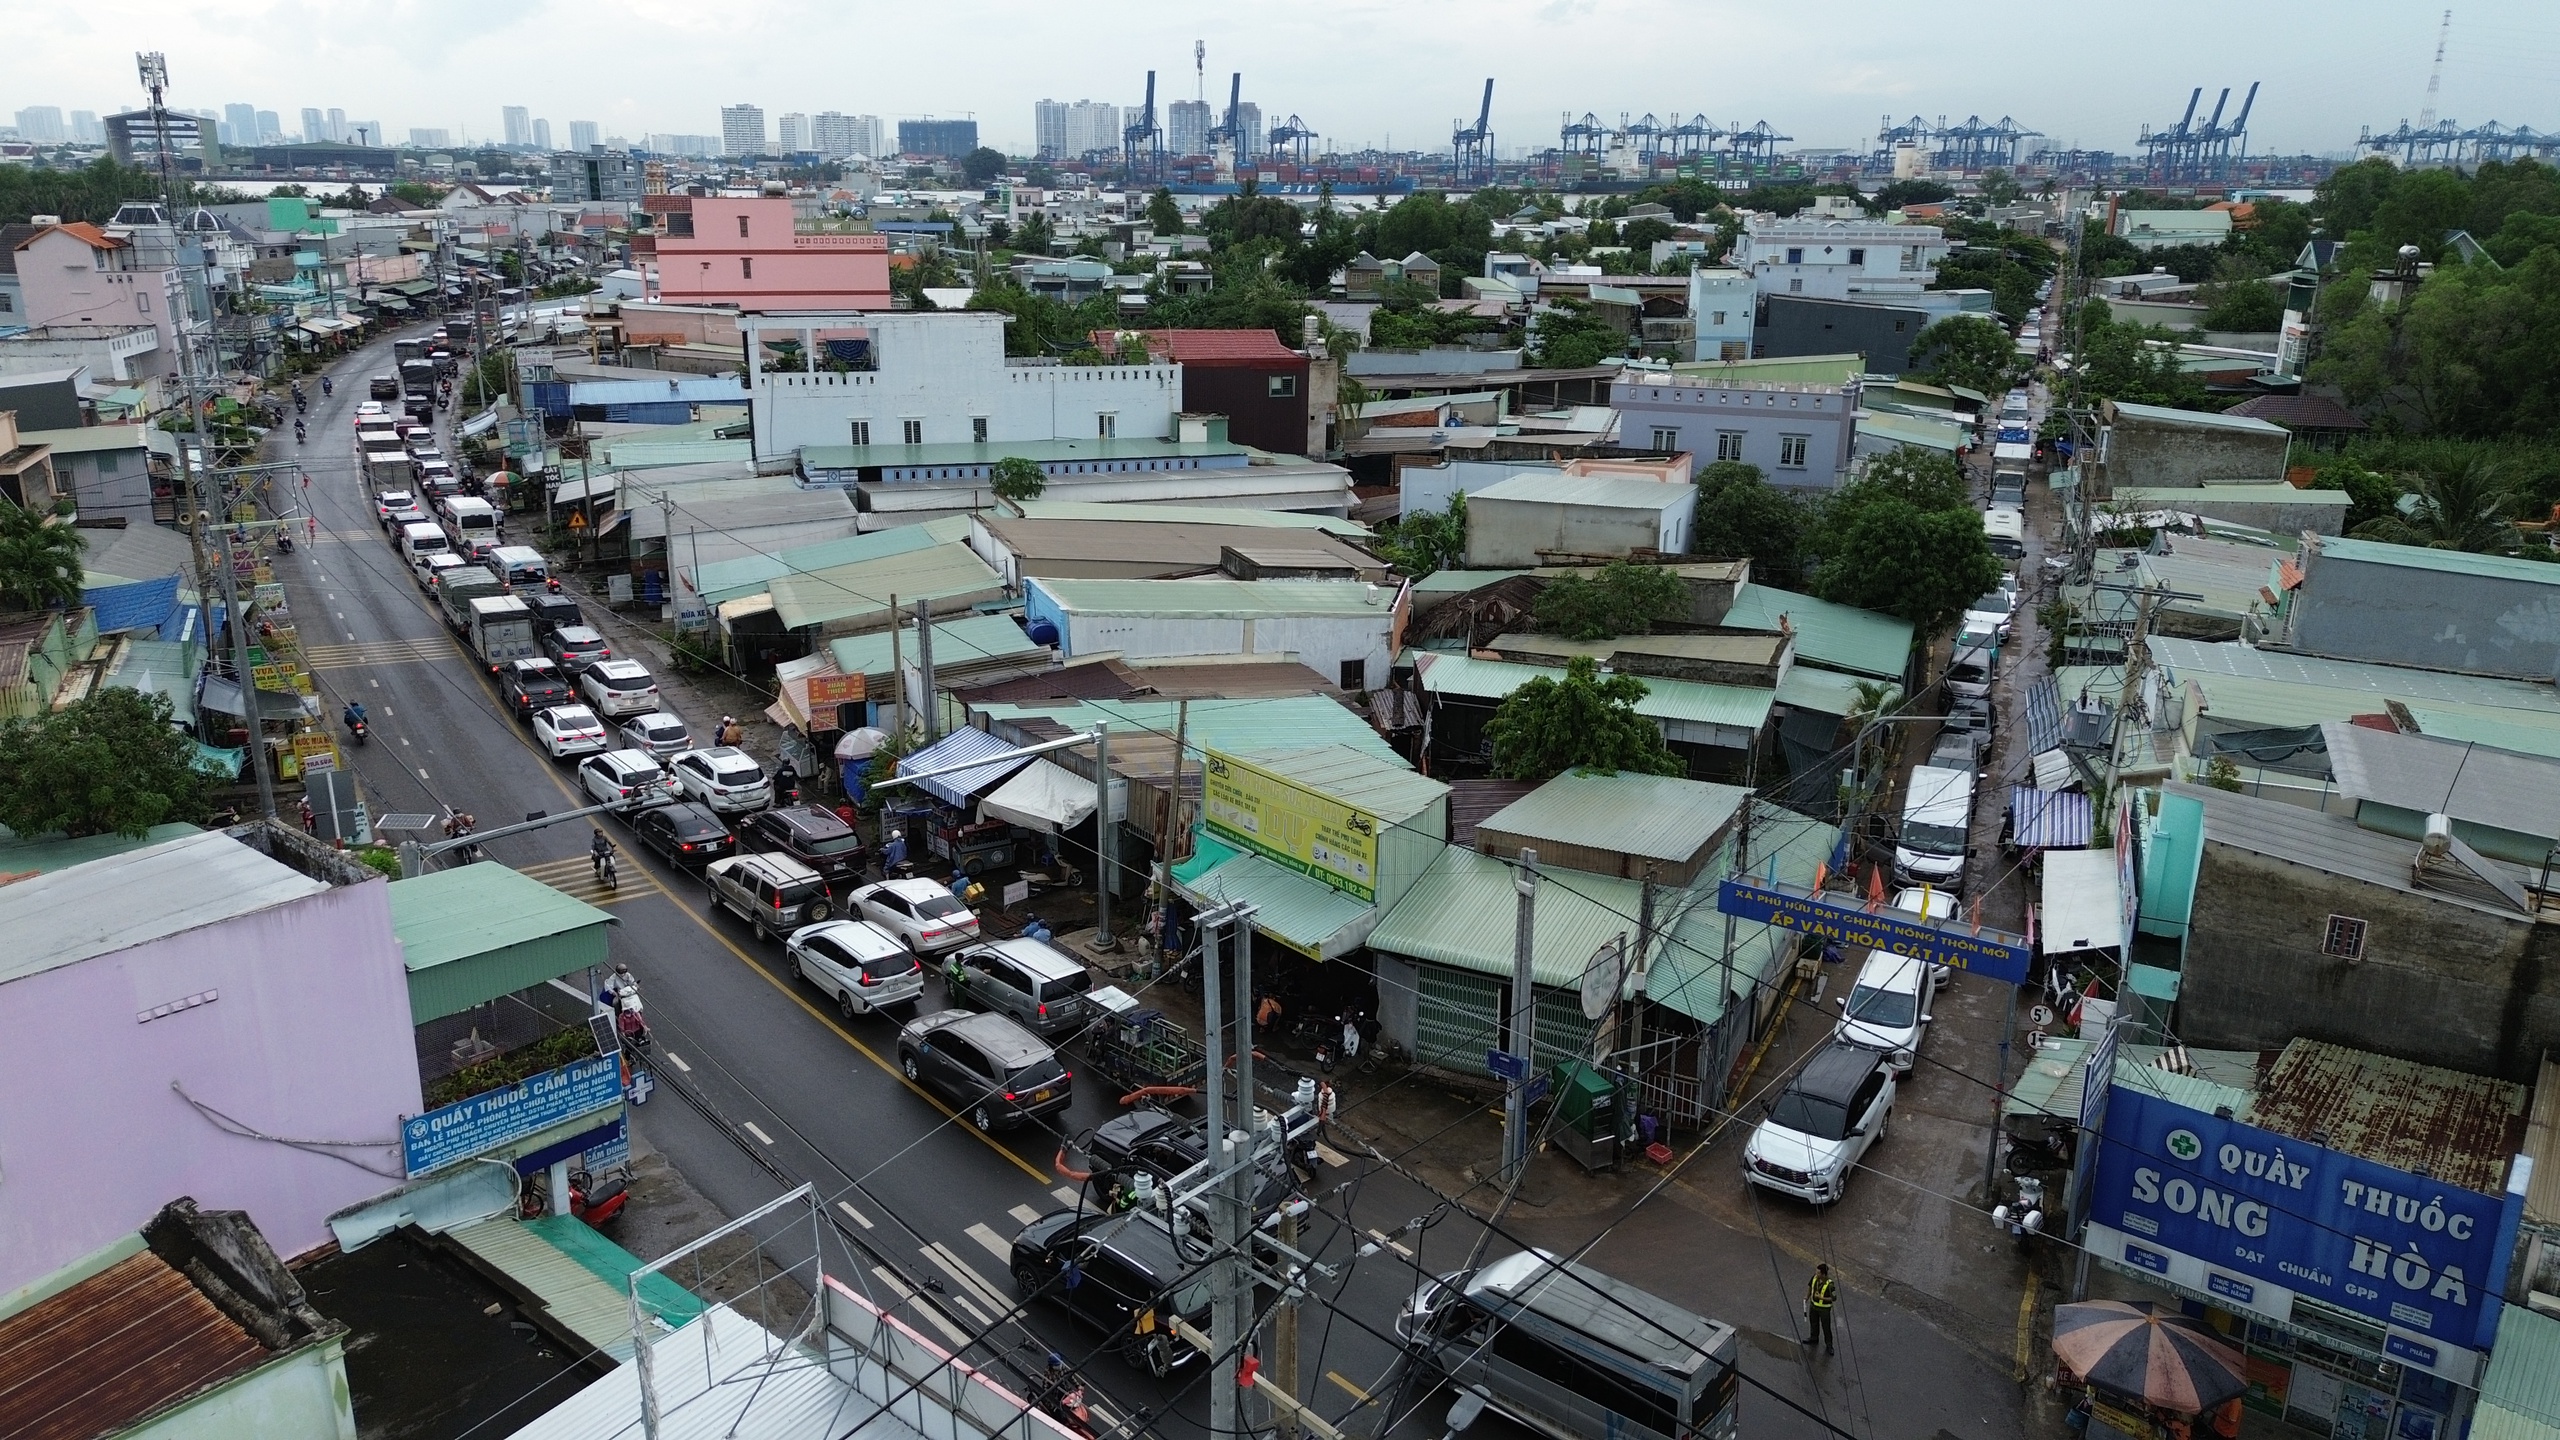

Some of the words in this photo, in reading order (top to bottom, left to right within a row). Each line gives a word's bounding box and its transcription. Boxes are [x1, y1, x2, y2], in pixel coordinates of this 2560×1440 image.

[545, 481, 561, 489] NAM
[681, 609, 696, 619] RỬA
[697, 609, 706, 618] XE
[1320, 822, 1332, 835] THAY
[1331, 826, 1340, 839] THẾ
[1340, 830, 1349, 844] PHỤ
[1340, 841, 1351, 853] CÁC
[1361, 850, 1367, 860] XE
[1314, 867, 1325, 881] ĐT:
[1735, 888, 1753, 900] XÃ
[1757, 894, 1781, 907] PHÚ
[1785, 900, 1811, 914] HỮU
[1814, 907, 1839, 921] ĐẠT
[1843, 914, 1891, 932] CHUẨN
[1895, 926, 1936, 942] NÔNG
[1940, 936, 1979, 952] THÔN
[1982, 946, 2010, 960] MỚI
[1769, 910, 1795, 927] ẤP
[1800, 919, 1840, 939] VĂN
[1845, 930, 1887, 950] HÓA
[1892, 942, 1933, 960] CÁT
[1938, 952, 1968, 970] LÁI
[445, 1121, 475, 1138] THUỐC
[477, 1110, 508, 1127] PHÒNG
[509, 1105, 521, 1114] VÀ
[548, 1088, 571, 1100] BỆNH
[572, 1081, 589, 1093] CHO
[591, 1071, 617, 1086] NGƯỜI
[606, 1142, 628, 1156] DUNG
[2219, 1144, 2311, 1190] QUẦY
[2342, 1179, 2474, 1241] THUỐC
[2131, 1167, 2269, 1238] SONG
[2348, 1234, 2468, 1307] HÒA
[2137, 1250, 2156, 1261] THUỐC
[2235, 1245, 2265, 1265] ĐẠT
[2278, 1261, 2333, 1287] CHUẨN
[2345, 1283, 2379, 1301] GPP
[2212, 1283, 2229, 1294] CHỨC
[2213, 1276, 2230, 1286] THỰC
[2232, 1281, 2251, 1294] PHẨM
[2214, 1298, 2270, 1325] SONG
[2409, 1347, 2431, 1360] PHẨM
